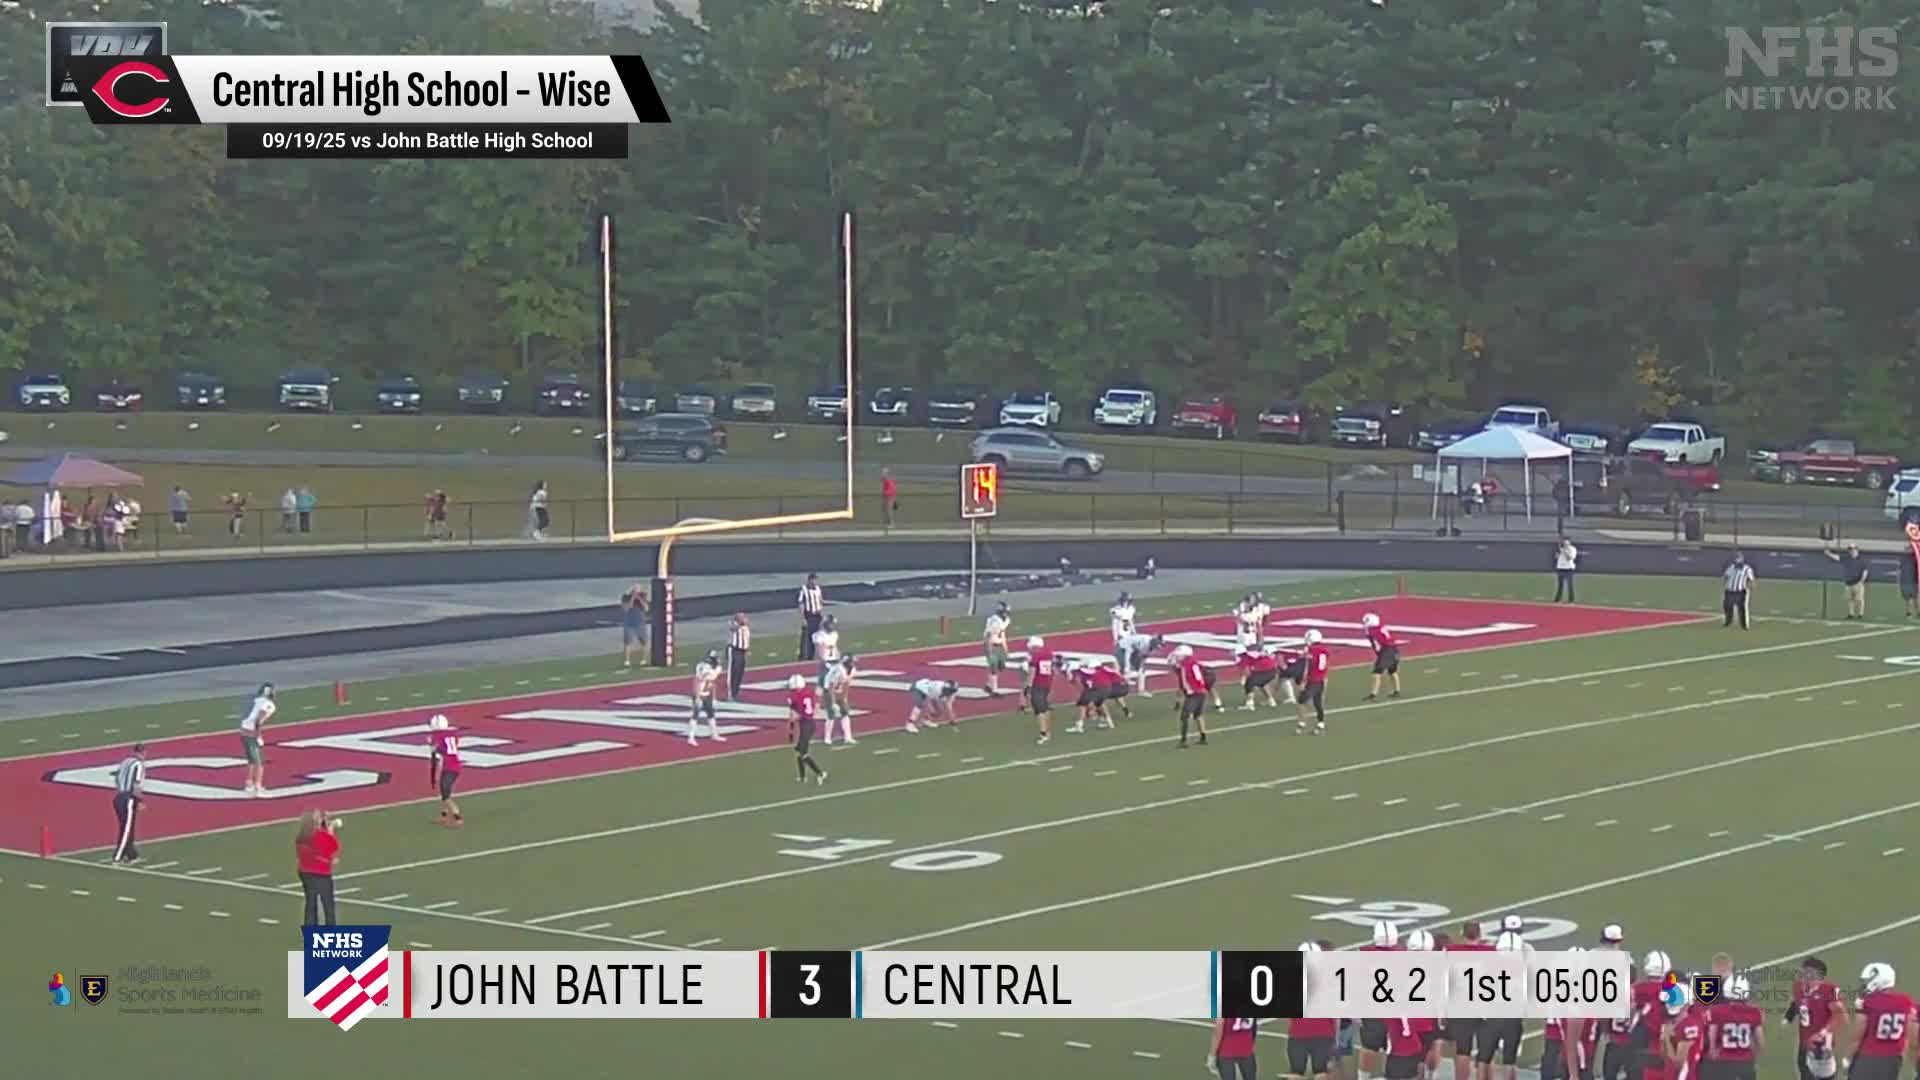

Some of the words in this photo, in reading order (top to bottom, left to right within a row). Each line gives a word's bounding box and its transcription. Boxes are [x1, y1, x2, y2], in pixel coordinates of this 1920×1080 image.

[974, 467, 997, 504] 14
[1722, 1023, 1752, 1049] 20
[1877, 1013, 1906, 1040] 65
